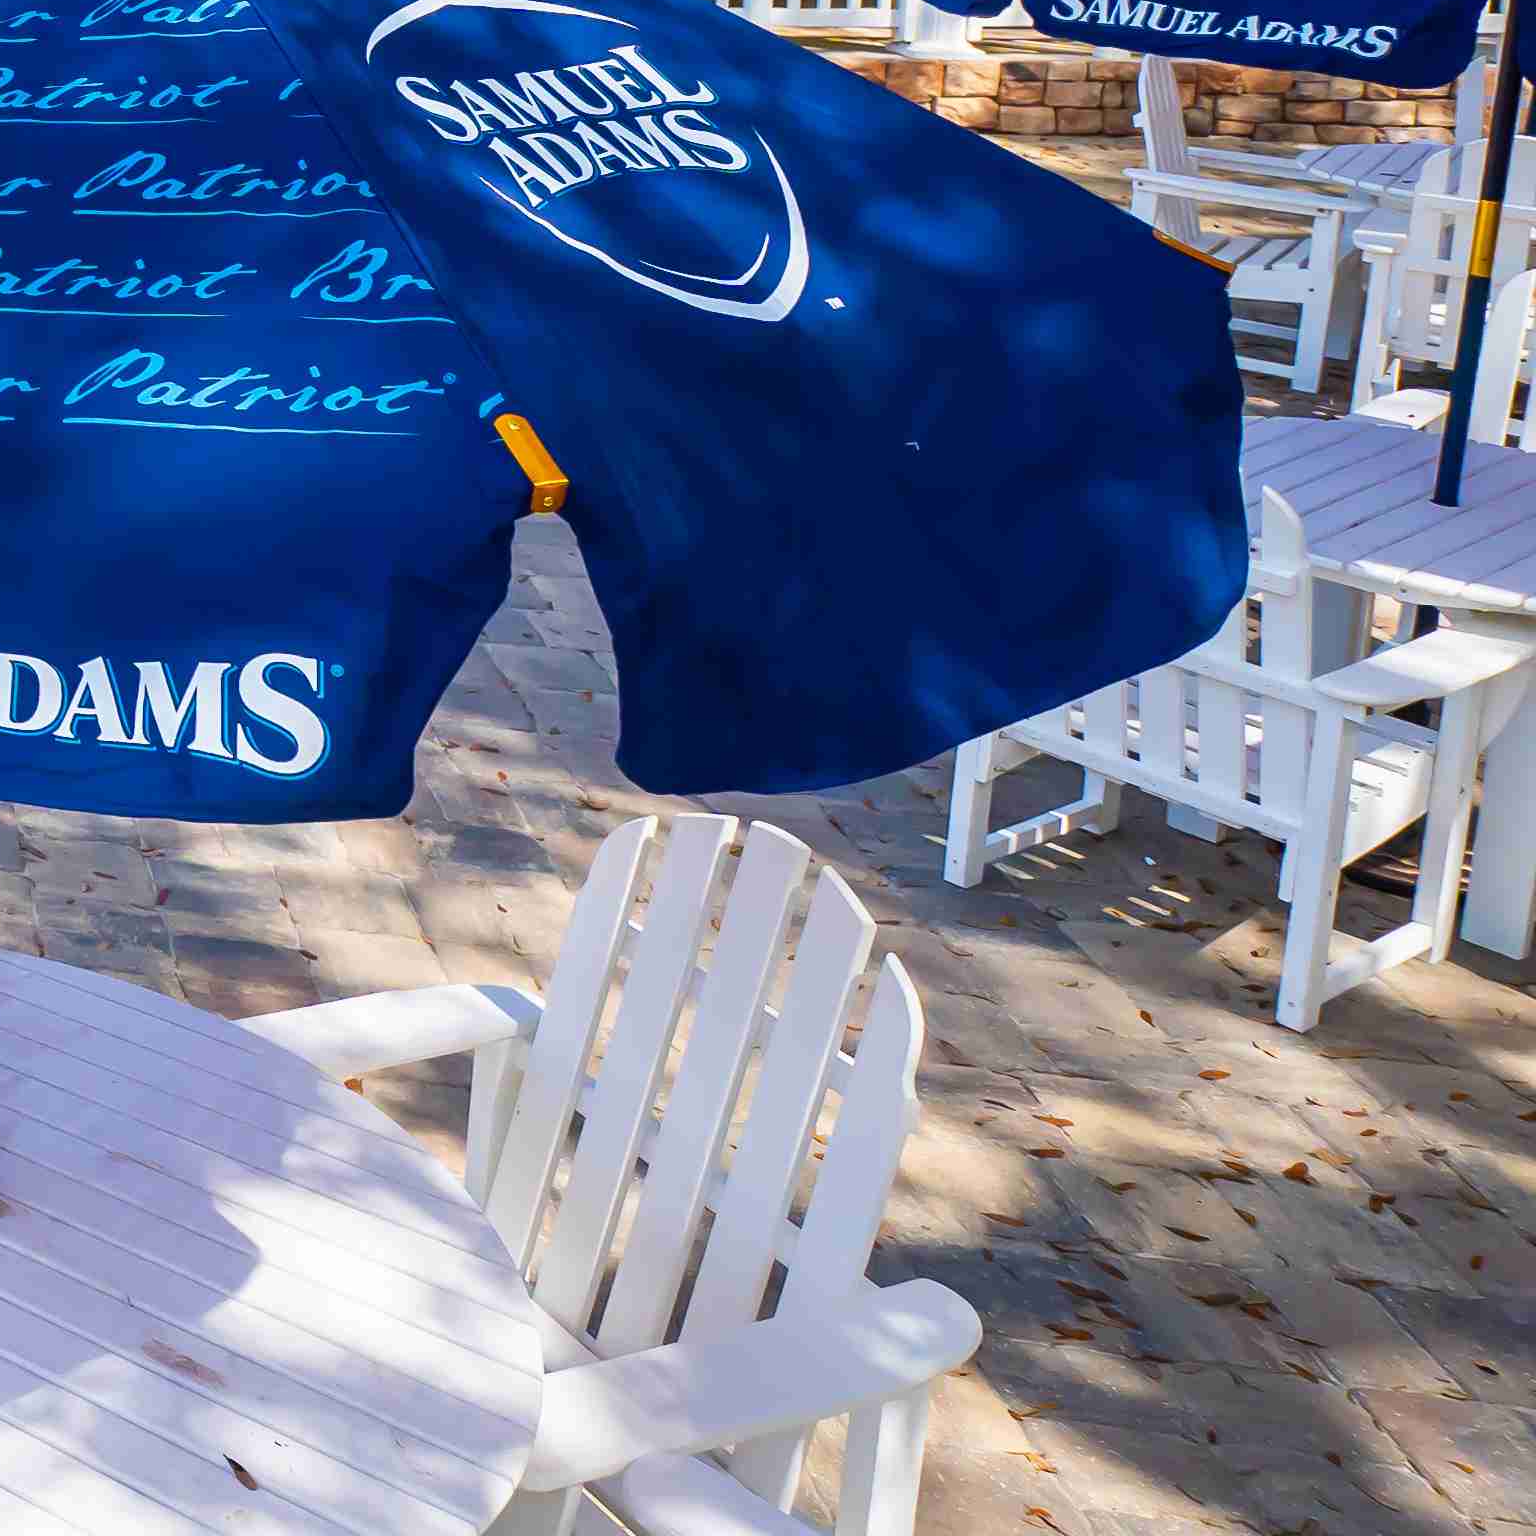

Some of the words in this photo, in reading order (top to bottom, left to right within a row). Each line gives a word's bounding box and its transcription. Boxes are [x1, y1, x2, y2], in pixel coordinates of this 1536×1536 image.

[1227, 15, 1398, 59] ADAMS
[394, 44, 718, 145] SAMUEL
[487, 109, 752, 210] ADAMS
[63, 348, 446, 415] Patriot
